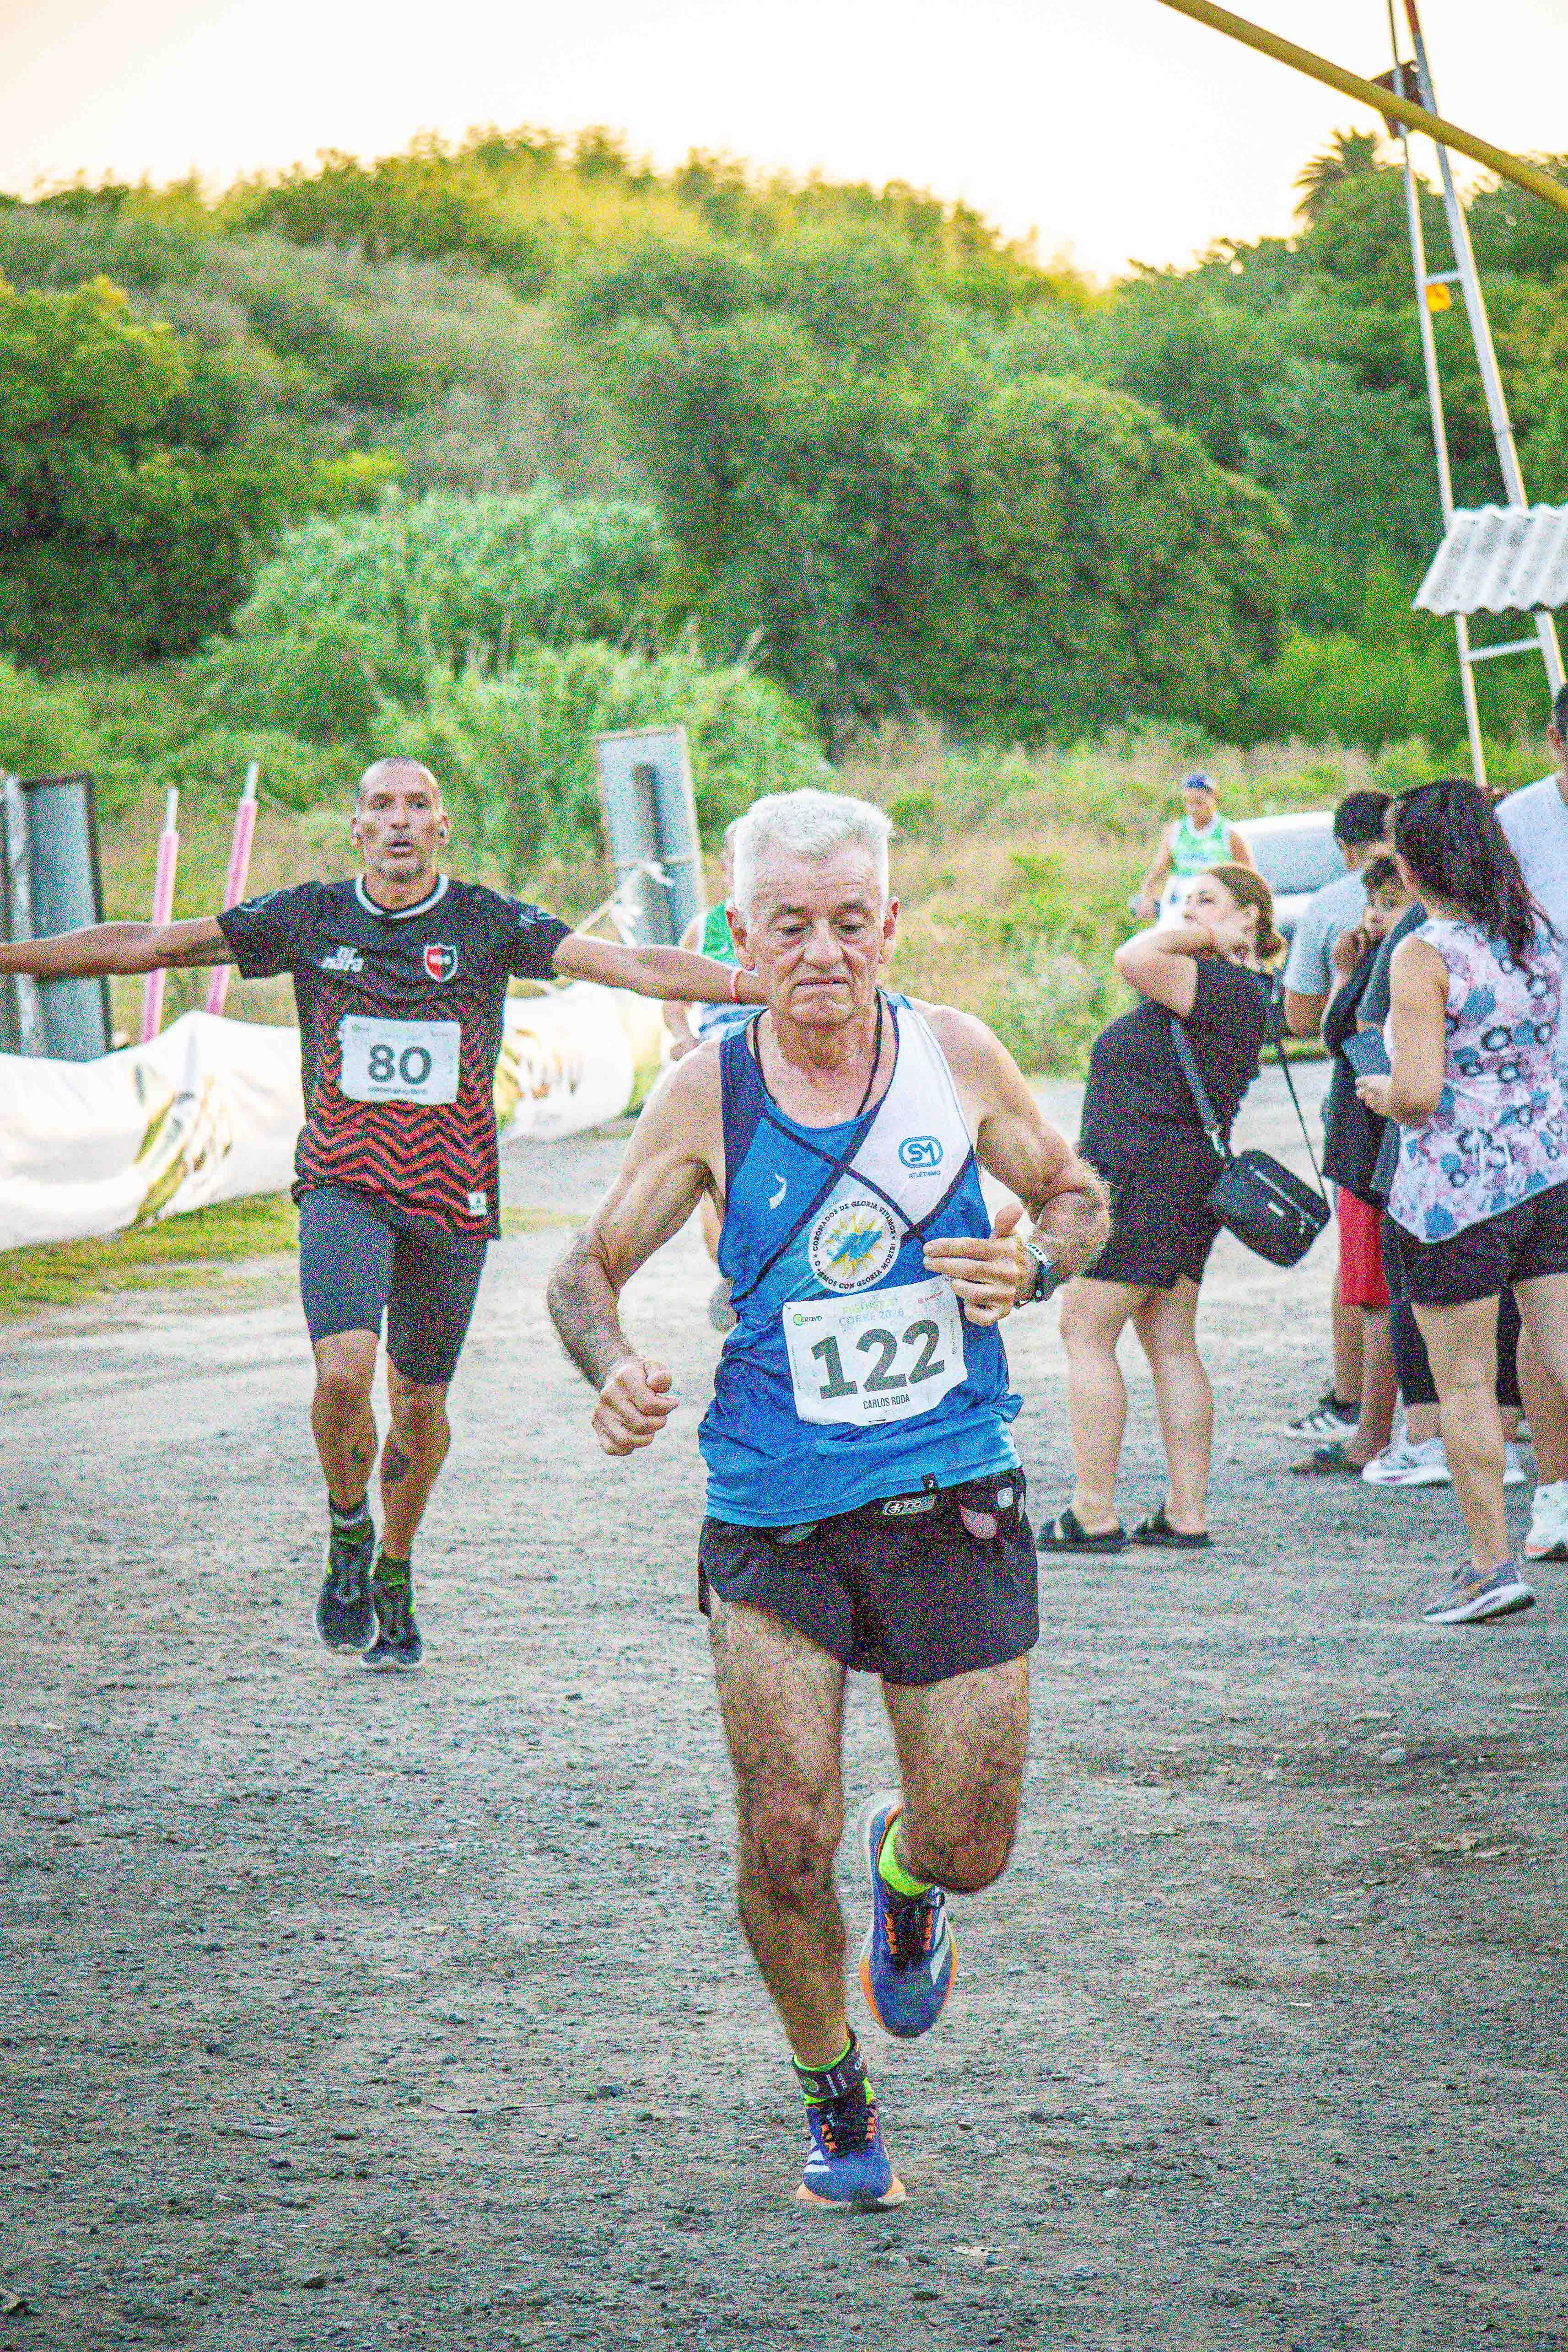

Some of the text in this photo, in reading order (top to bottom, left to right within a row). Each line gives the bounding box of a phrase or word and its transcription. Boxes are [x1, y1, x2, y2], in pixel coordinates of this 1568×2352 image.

[368, 1044, 432, 1085] 80
[813, 1209, 839, 1252] CORONADOS
[851, 1200, 878, 1210] GLORIA
[857, 1270, 882, 1287] GLORIA
[811, 1319, 945, 1399] 122
[863, 1394, 910, 1410] CARLOS RODA
